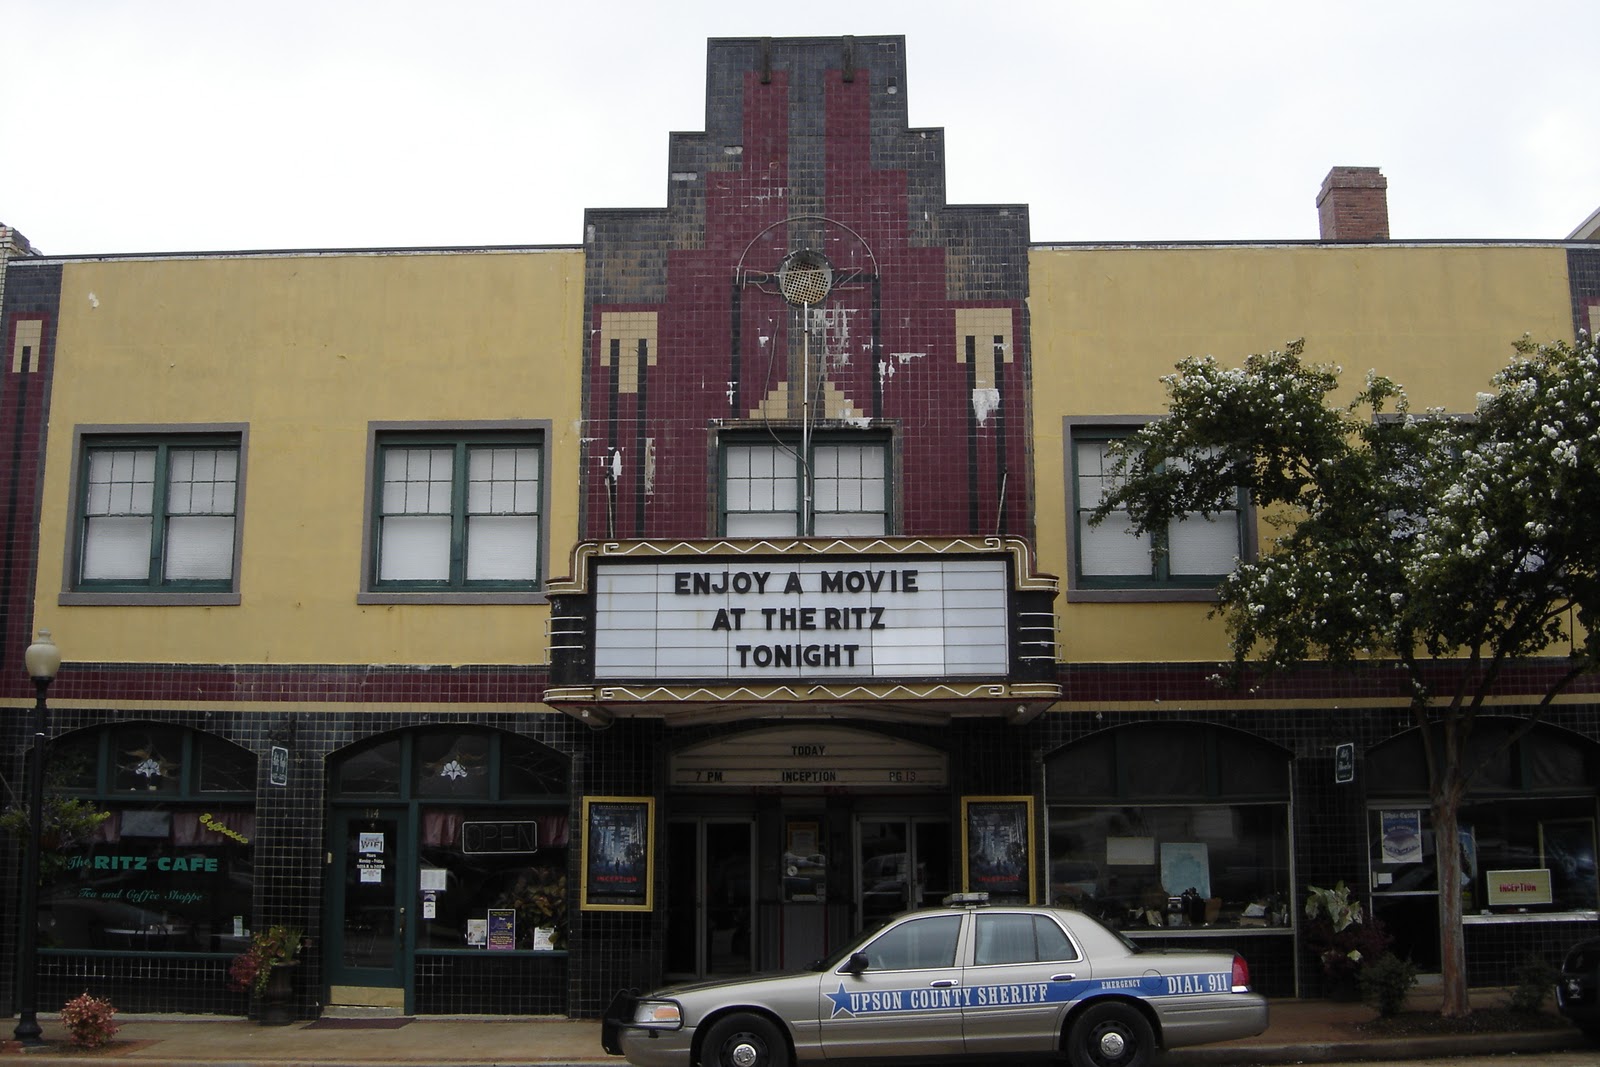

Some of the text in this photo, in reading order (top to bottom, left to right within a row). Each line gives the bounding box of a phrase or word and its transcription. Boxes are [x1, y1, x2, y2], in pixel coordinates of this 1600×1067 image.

[674, 570, 919, 595] ENJOY A MOVIE
[711, 607, 886, 631] AT THE RITZ
[736, 644, 860, 668] TONIGHT
[791, 745, 826, 756] TODAY
[696, 772, 702, 781] 7
[707, 772, 723, 781] PM
[781, 771, 836, 782] INCEPTION
[465, 824, 535, 851] OPEN
[67, 855, 218, 872] The RITZ CAFE
[596, 875, 638, 883] INCEPTION
[1499, 882, 1537, 893] INCEPTION
[78, 887, 203, 904] Tea and Coffee Shoppe
[1101, 973, 1228, 994] EMERGENCY DIAL 911
[850, 983, 1048, 1012] UPSON COUNTY SHERIFF
